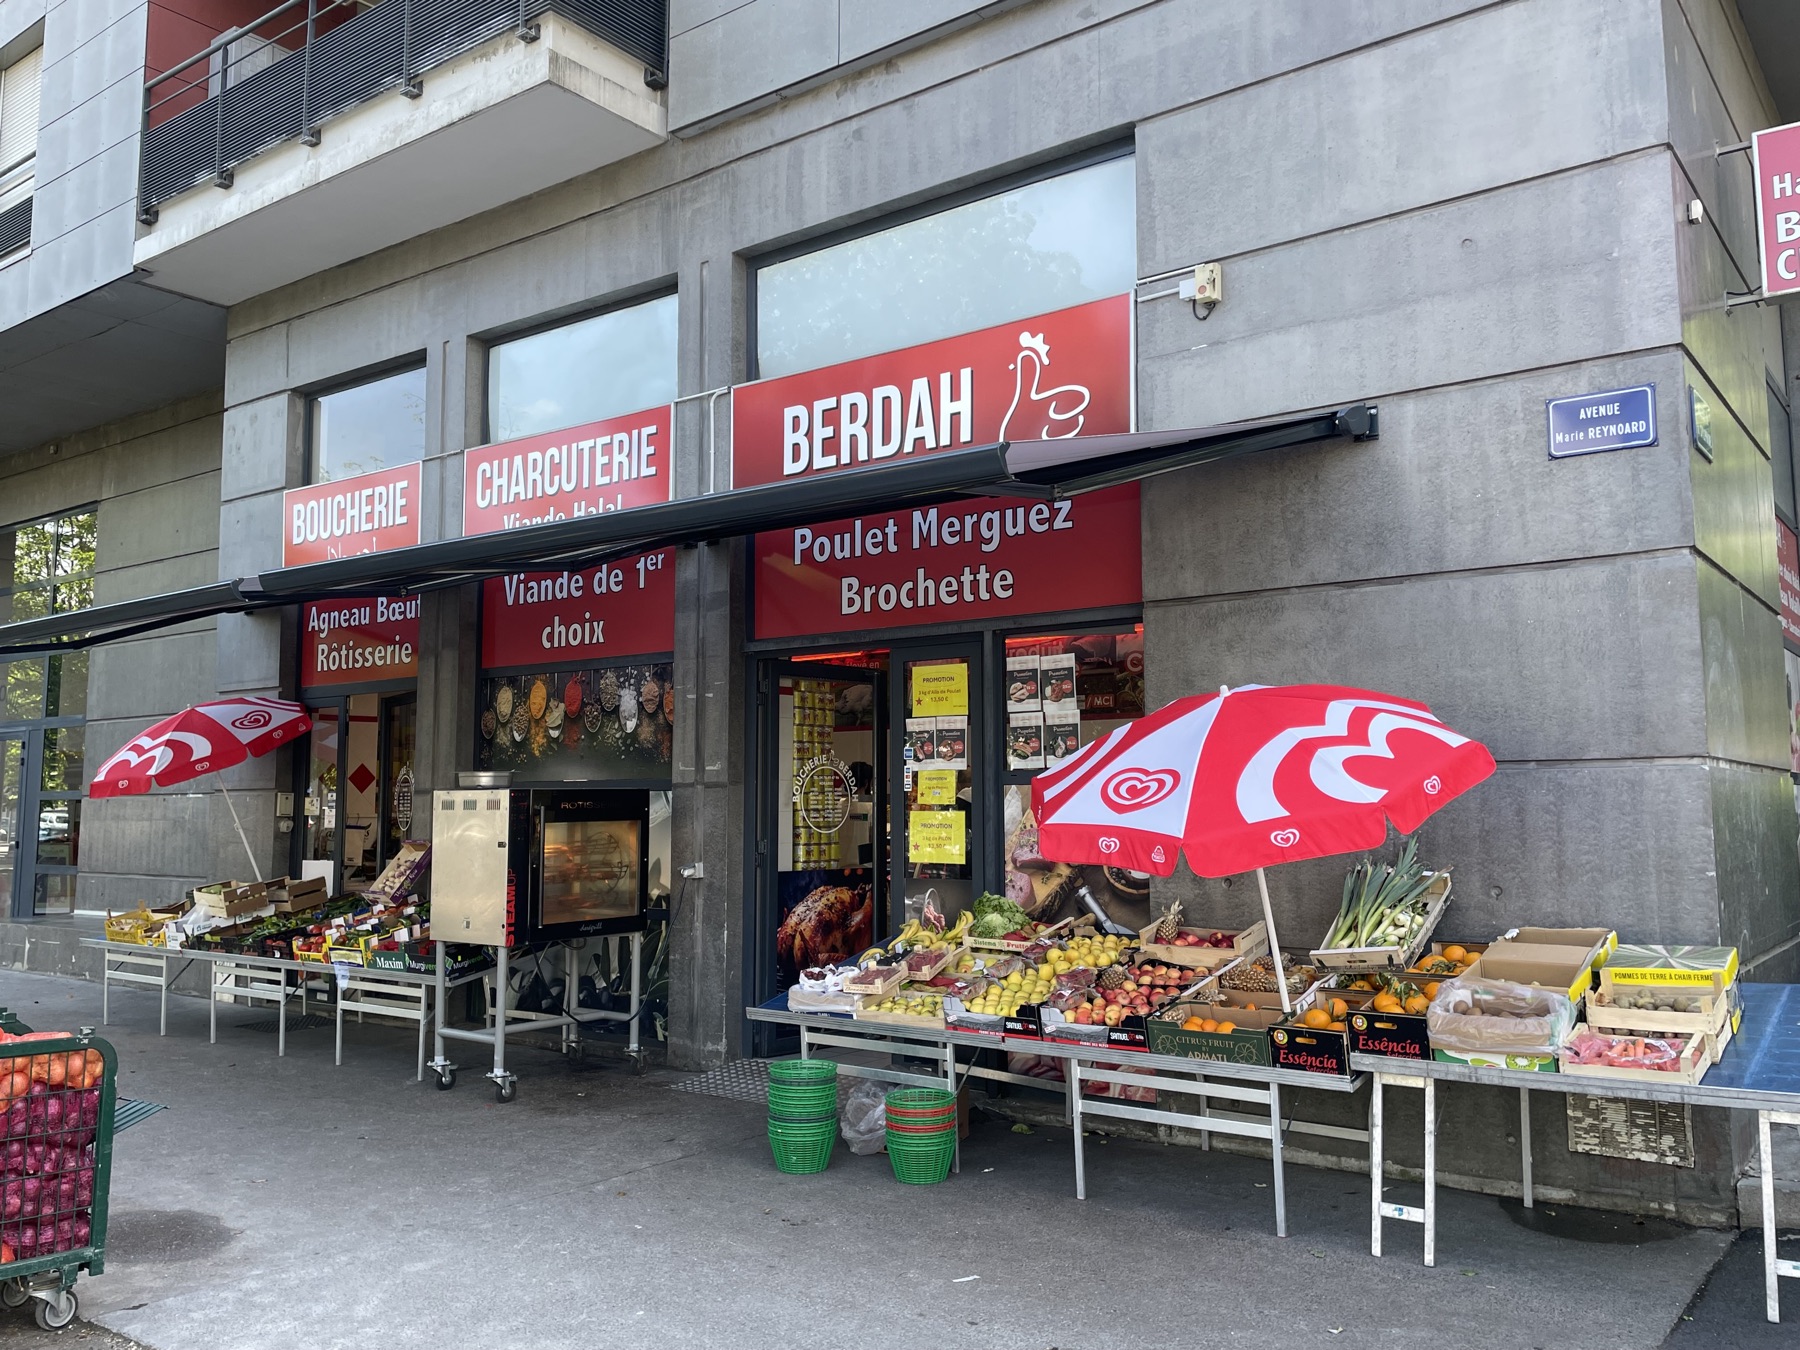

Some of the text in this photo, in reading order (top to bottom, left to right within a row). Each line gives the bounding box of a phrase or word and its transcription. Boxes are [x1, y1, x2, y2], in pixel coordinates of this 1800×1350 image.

[783, 366, 974, 476] BERDAH
[1579, 402, 1621, 420] AVENUE
[1555, 420, 1647, 444] Marie REYNOARD
[476, 425, 658, 509] CHARCUTERIE
[292, 480, 409, 546] BOUCHERIE
[793, 499, 1074, 566] Poulet Merguez
[504, 552, 664, 606] Viande de 1er
[840, 564, 1014, 616] Brochette
[308, 605, 370, 638] Agneau
[541, 612, 605, 650] choix
[316, 635, 413, 672] Rôtisserie
[792, 754, 859, 802] BOUCHERIE BERDAH
[974, 938, 996, 947] Sistema
[376, 956, 404, 970] Maxim
[410, 960, 437, 972] Murgiver
[1176, 1035, 1235, 1048] CITRUS FRUIT
[1188, 1050, 1227, 1062] ADMATI
